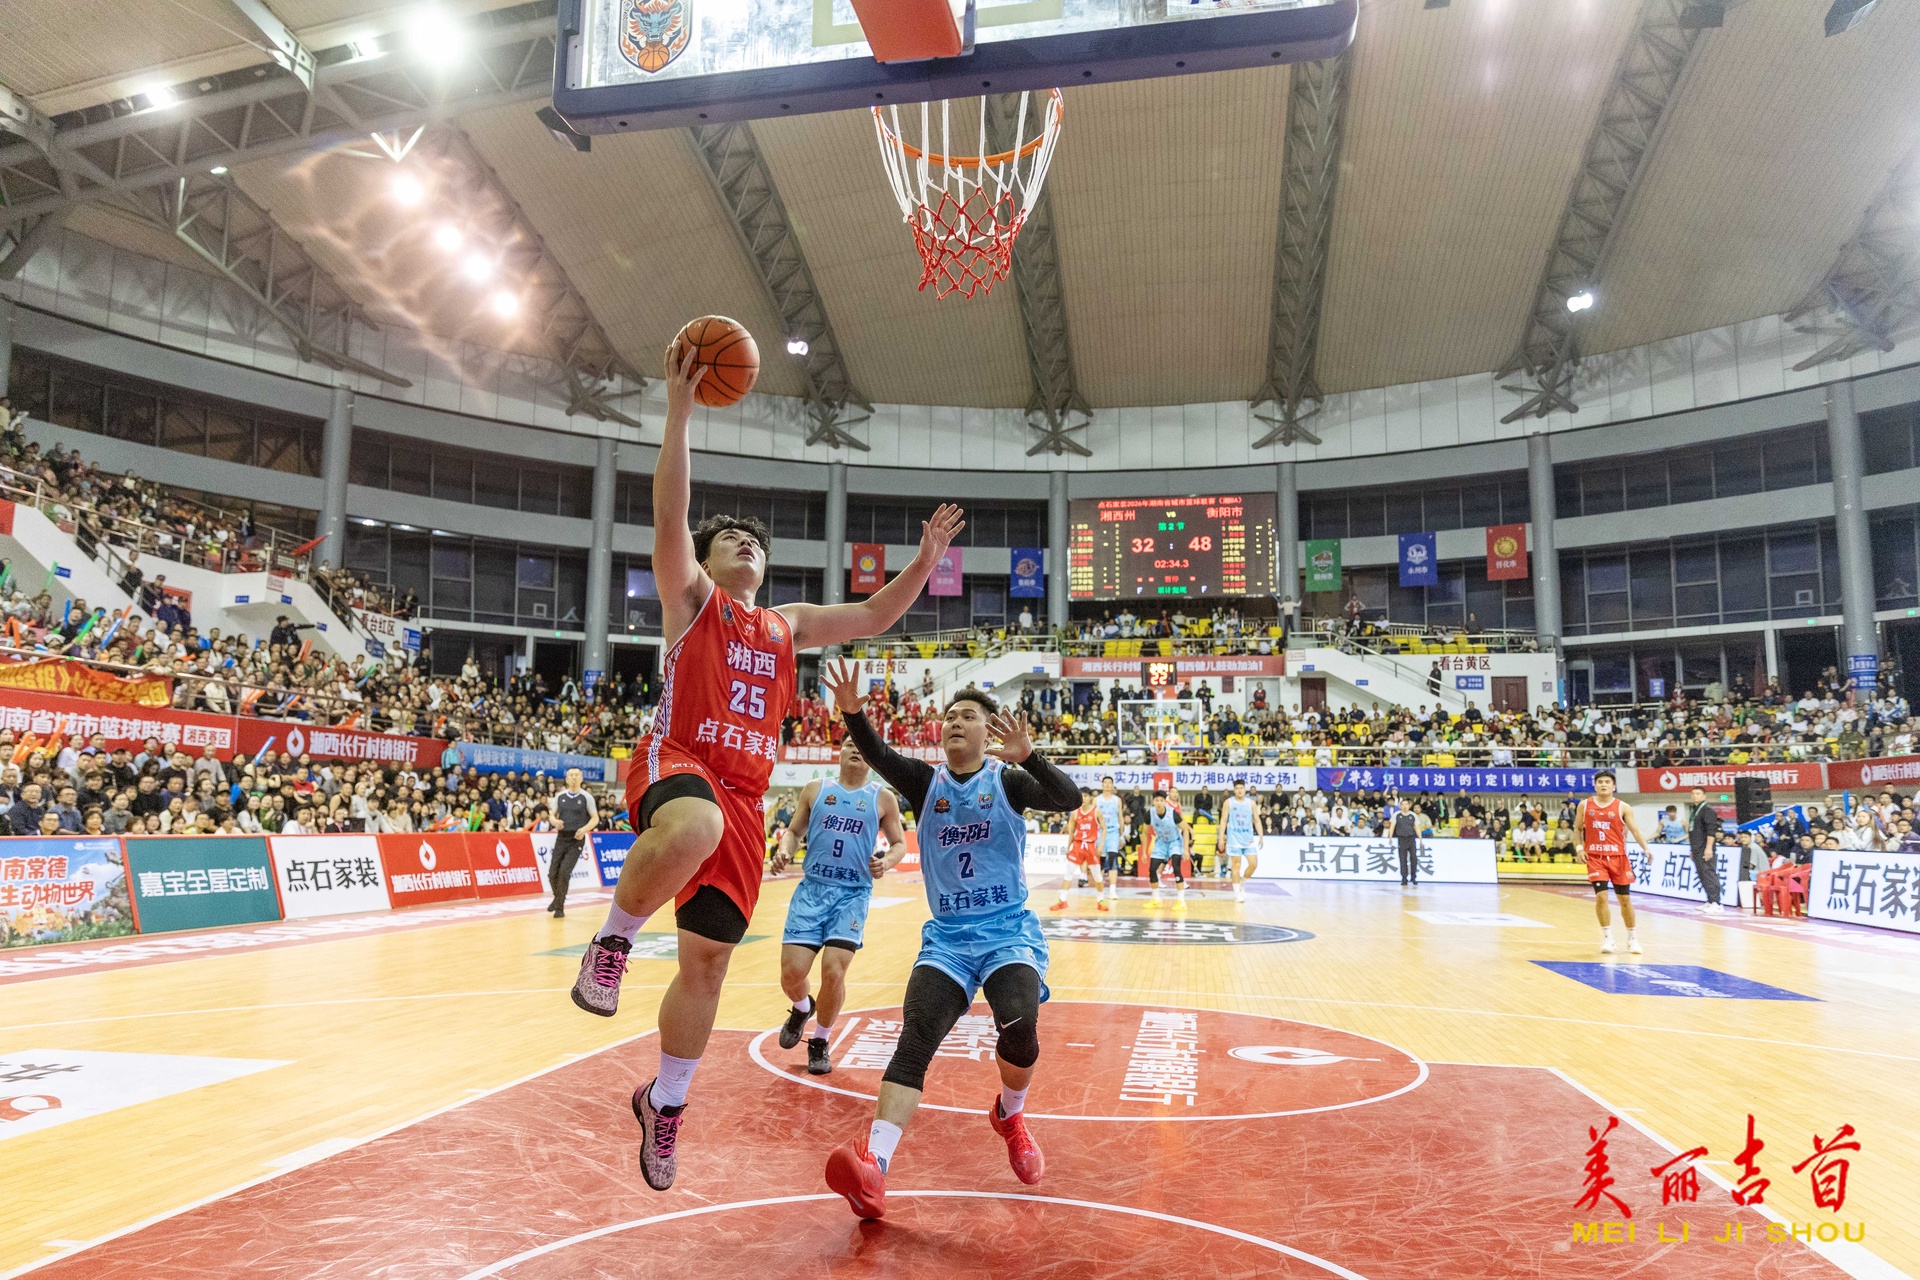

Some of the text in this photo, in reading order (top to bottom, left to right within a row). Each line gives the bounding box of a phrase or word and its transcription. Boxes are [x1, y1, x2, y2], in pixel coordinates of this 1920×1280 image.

[1100, 510, 1136, 522] 湘西州
[1206, 506, 1243, 518] 衡阳市
[1132, 537, 1155, 553] 32
[1188, 536, 1212, 551] 48
[1154, 559, 1189, 569] 02:34.3
[360, 612, 396, 637] 看台红区
[727, 641, 777, 680] 湘西
[1438, 655, 1492, 671] 看台黄区
[730, 680, 766, 720] 25
[0, 706, 230, 747] 南省城市篮球联赛 湘西赛区
[309, 730, 418, 762] 湘西长行村镇银行
[696, 717, 777, 762] 点石家装
[1115, 771, 1154, 784] 实力护
[1176, 771, 1297, 785] 助力湘BA燃动全场!
[823, 814, 864, 835] 衡阳
[939, 820, 991, 847] 衡阳
[832, 839, 844, 858] 9
[1297, 842, 1435, 876] 点石家装
[0, 857, 67, 881] 南常德
[286, 857, 379, 893] 点石家装
[474, 866, 540, 887] 湘西长行村镇银行
[811, 862, 861, 882] 点石家装
[958, 852, 974, 879] 2
[138, 866, 270, 898] 嘉宝全屋定制
[390, 869, 473, 894] 湘西长行村镇银行
[940, 885, 1009, 912] 点石家装
